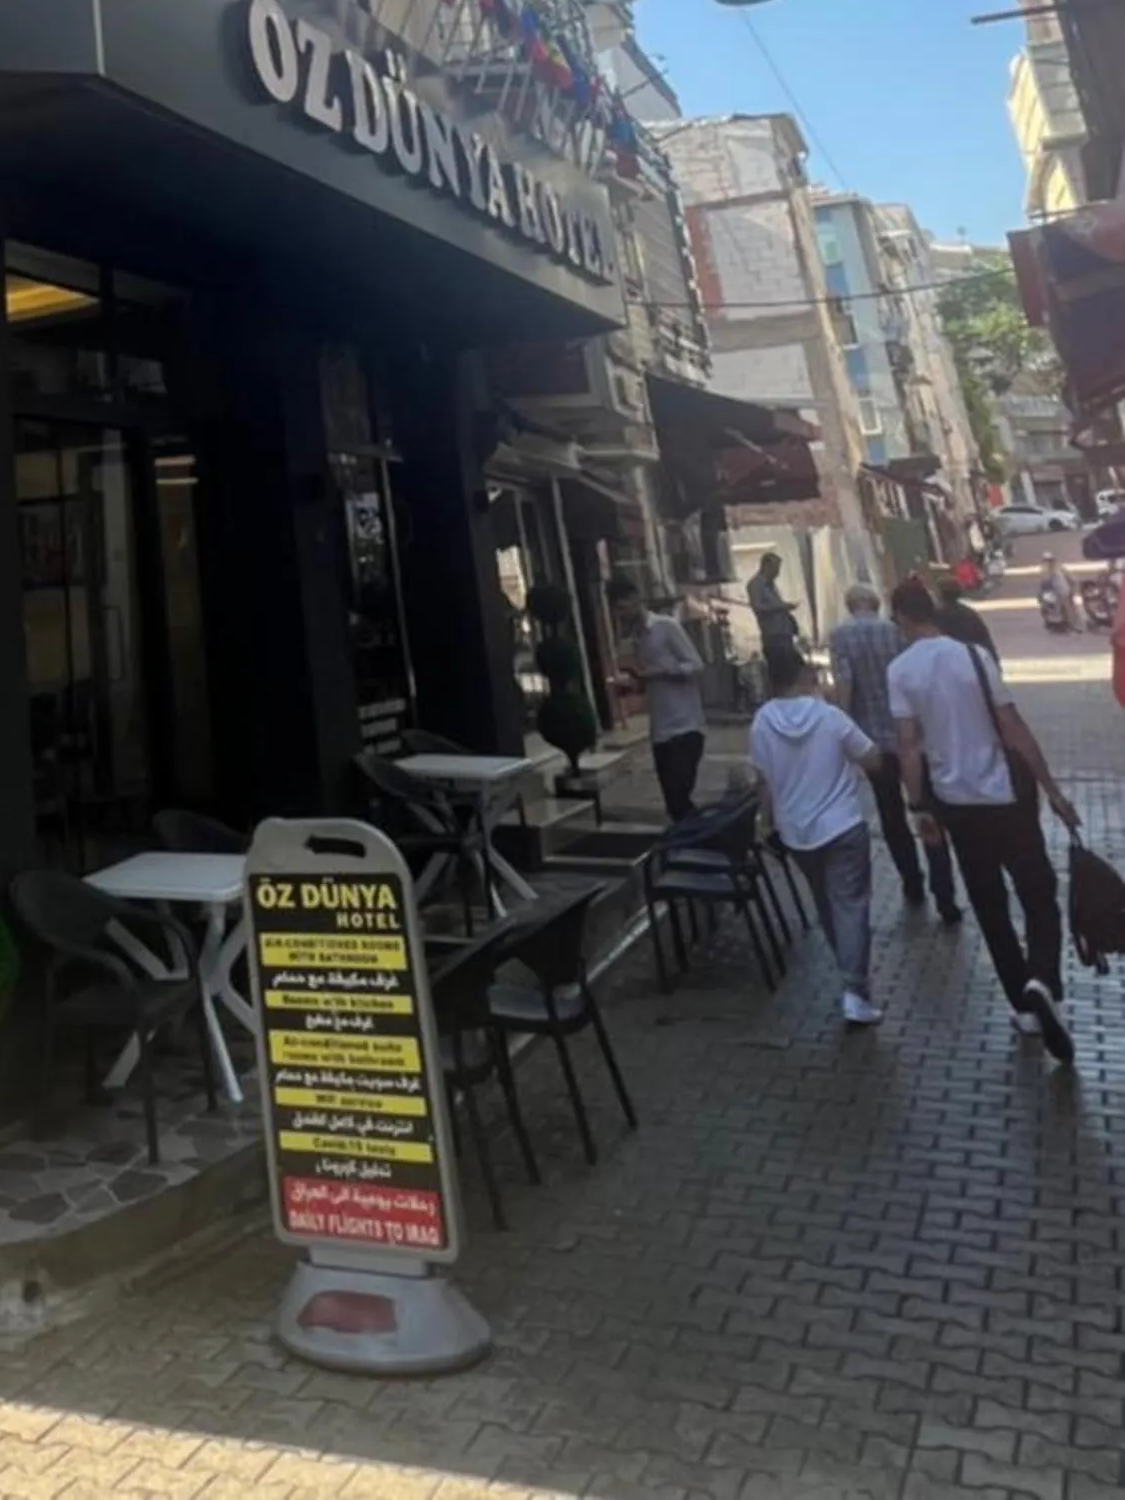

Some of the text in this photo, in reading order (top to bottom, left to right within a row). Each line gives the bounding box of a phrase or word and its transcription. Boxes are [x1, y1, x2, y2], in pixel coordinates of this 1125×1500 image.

[345, 48, 516, 228] DÜNYA
[257, 876, 397, 910] ÖZ DÜNYA
[336, 912, 401, 930] HOTEL
[328, 1212, 383, 1239] FLIGHTS
[384, 1220, 404, 1242] TO
[405, 1223, 441, 1246] IRAQ
